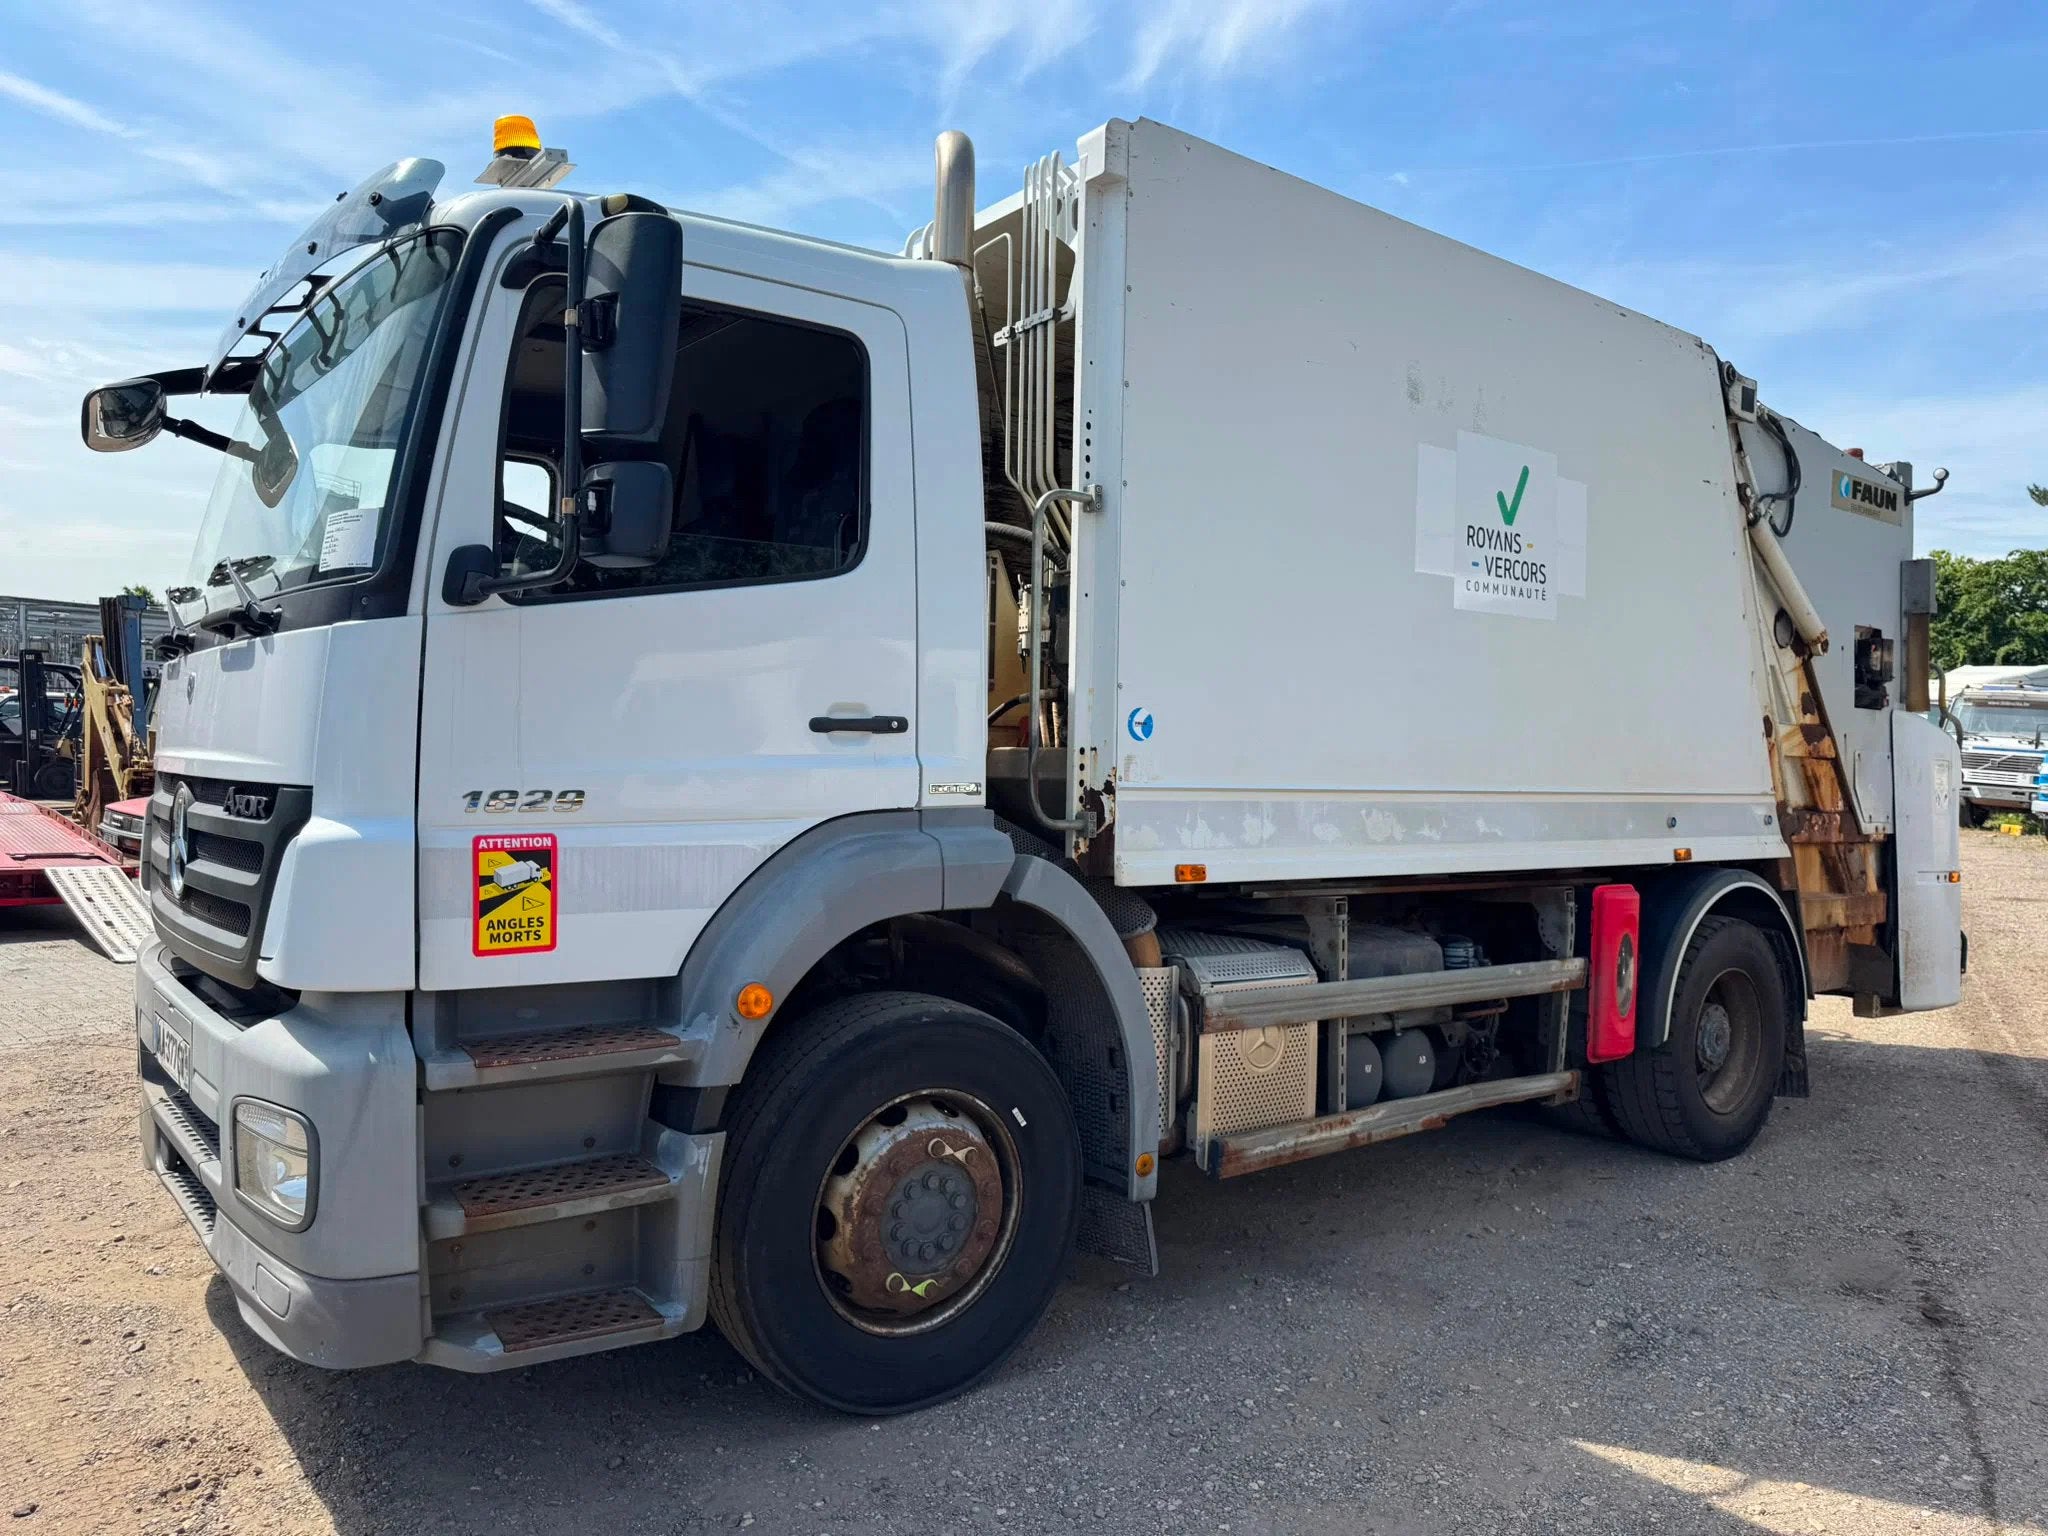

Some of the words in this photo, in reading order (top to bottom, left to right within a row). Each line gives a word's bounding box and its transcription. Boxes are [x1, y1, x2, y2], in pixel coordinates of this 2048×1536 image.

[1851, 480, 1897, 511] FAUN
[1466, 525, 1522, 554] ROYANS
[1484, 555, 1547, 585] VERCORS
[1465, 580, 1547, 601] COMMUNAUTÉ
[462, 789, 586, 814] 1829
[478, 836, 552, 849] ATTENTION
[486, 916, 545, 931] ANGLES
[489, 929, 542, 944] MORTS
